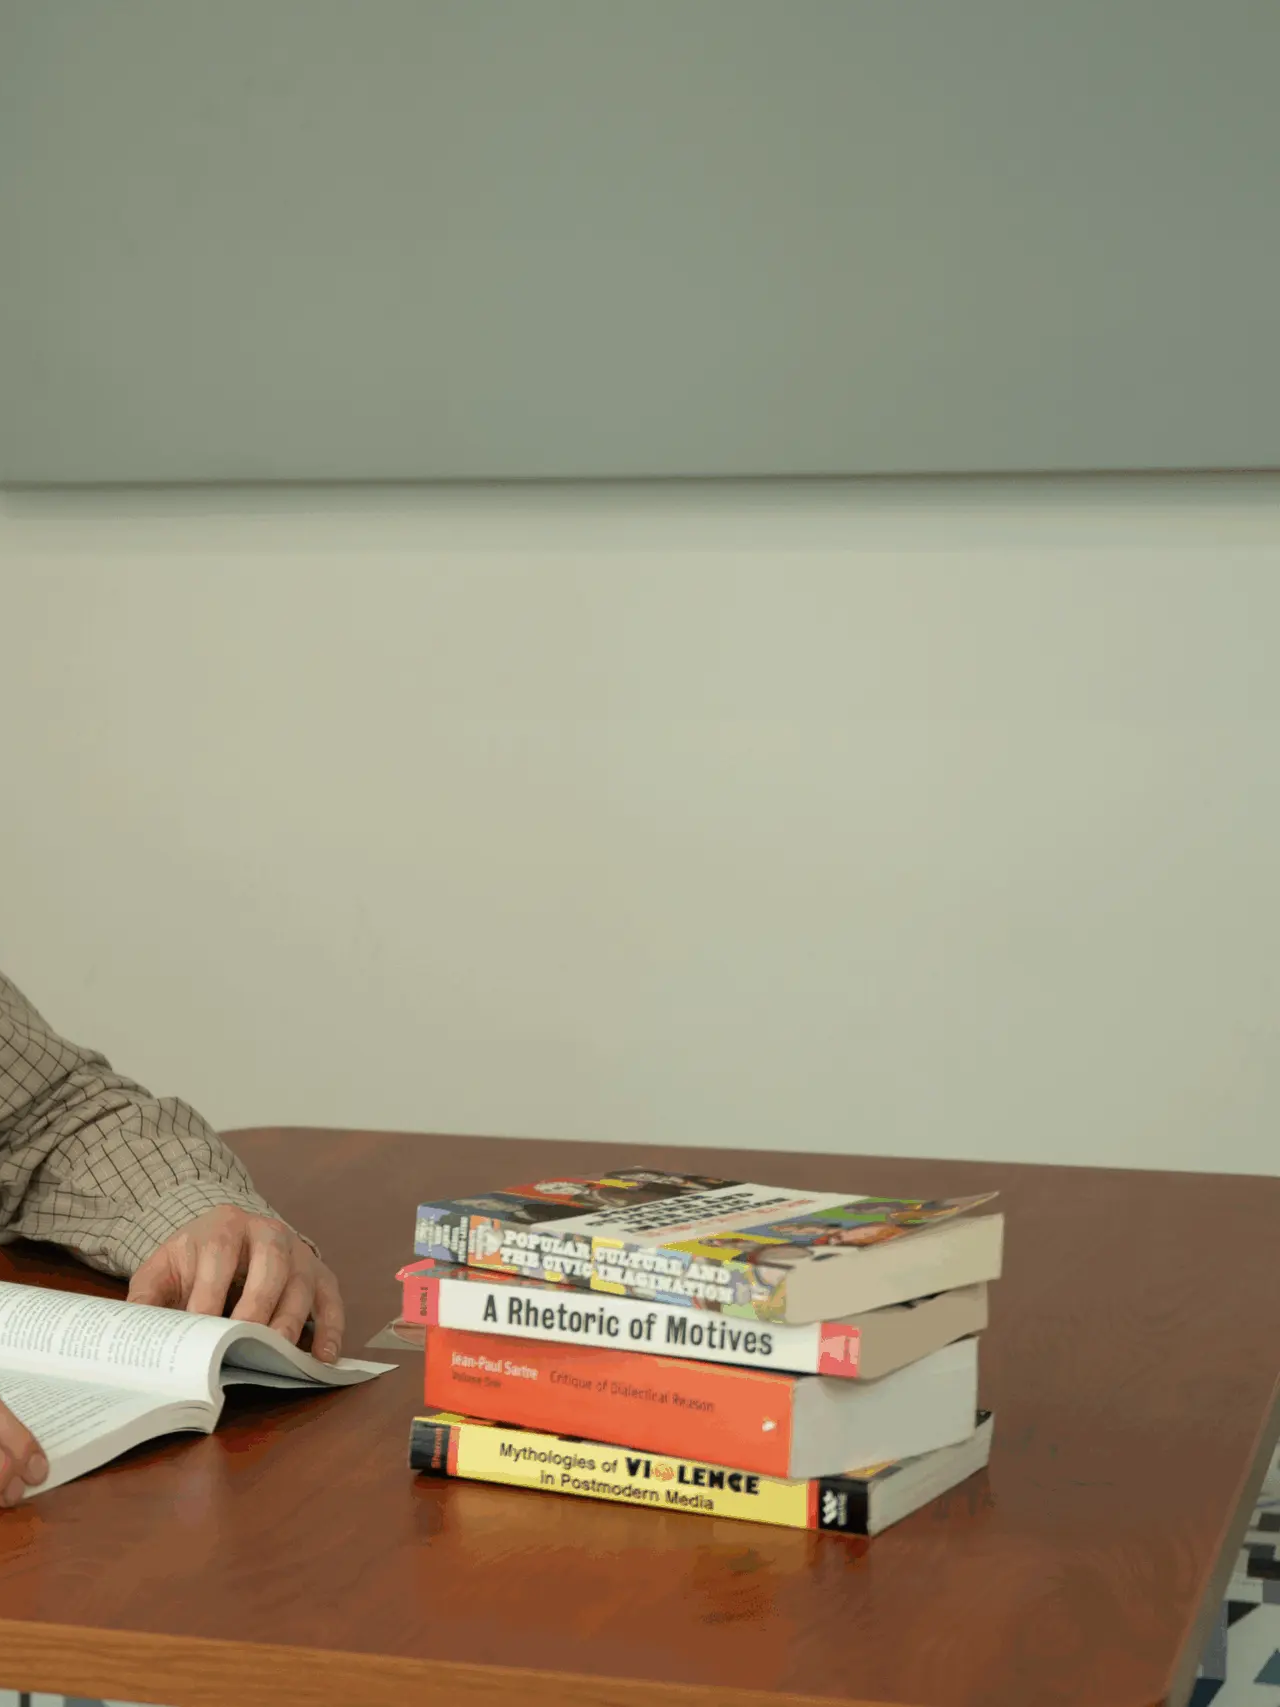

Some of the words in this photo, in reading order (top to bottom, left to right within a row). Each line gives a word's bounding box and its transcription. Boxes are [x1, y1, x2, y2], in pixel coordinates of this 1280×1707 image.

[500, 1247, 540, 1268] THE
[542, 1254, 593, 1278] CIVIC
[596, 1264, 734, 1303] IMAGINATION
[503, 1229, 590, 1260] POPULAR
[595, 1246, 683, 1277] CULTURE
[686, 1262, 732, 1284] AND
[483, 1293, 498, 1323] A
[508, 1296, 619, 1338] Rhetoric
[628, 1313, 657, 1342] of
[666, 1315, 773, 1356] Motives
[449, 1352, 502, 1374] Jean-Paul
[504, 1359, 538, 1381] Sartre
[550, 1370, 592, 1391] Critique
[596, 1380, 609, 1392] of
[611, 1382, 668, 1405] Dialectical
[673, 1392, 715, 1412] Reason
[499, 1442, 596, 1472] Mythologies
[601, 1459, 618, 1473] of
[540, 1470, 555, 1486] in
[560, 1473, 659, 1503] Postmodern
[665, 1490, 715, 1511] Media
